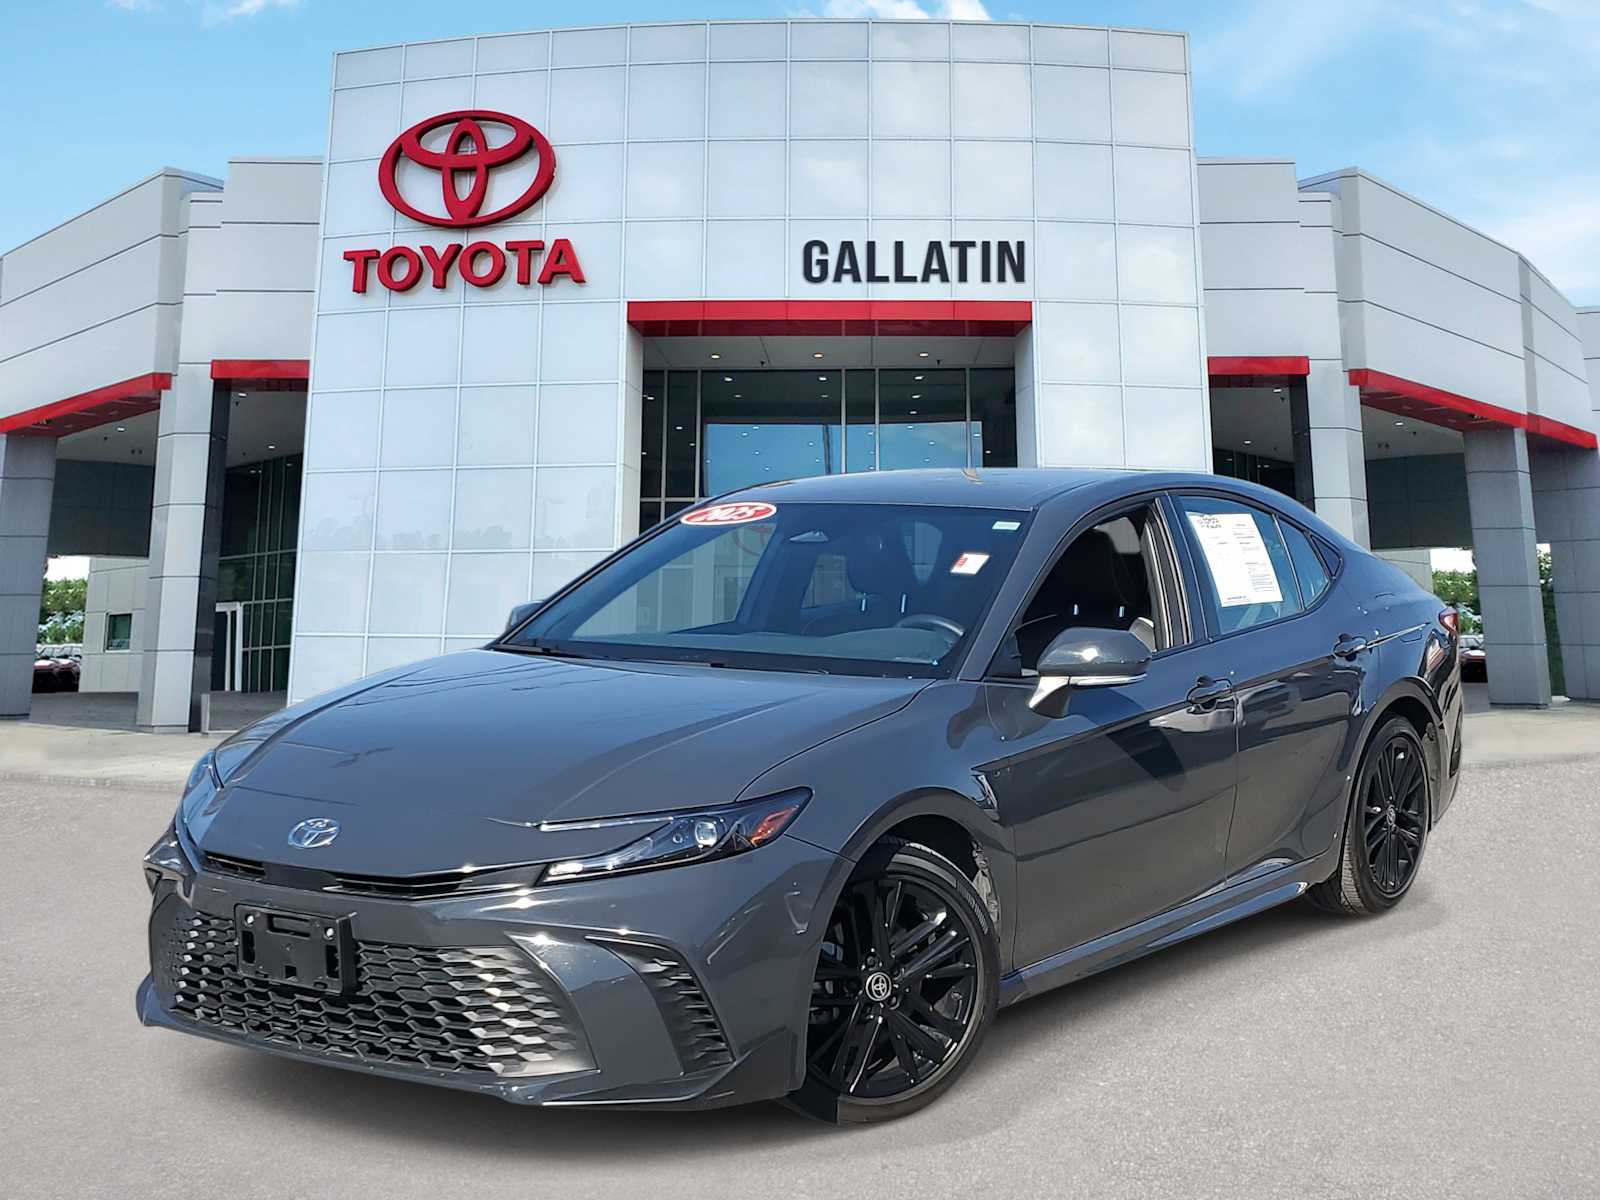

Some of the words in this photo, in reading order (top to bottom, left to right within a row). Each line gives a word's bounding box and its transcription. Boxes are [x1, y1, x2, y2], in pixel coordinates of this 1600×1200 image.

[343, 239, 586, 294] TOYOTA
[803, 240, 1025, 284] GALLATIN
[689, 505, 767, 522] 2025
